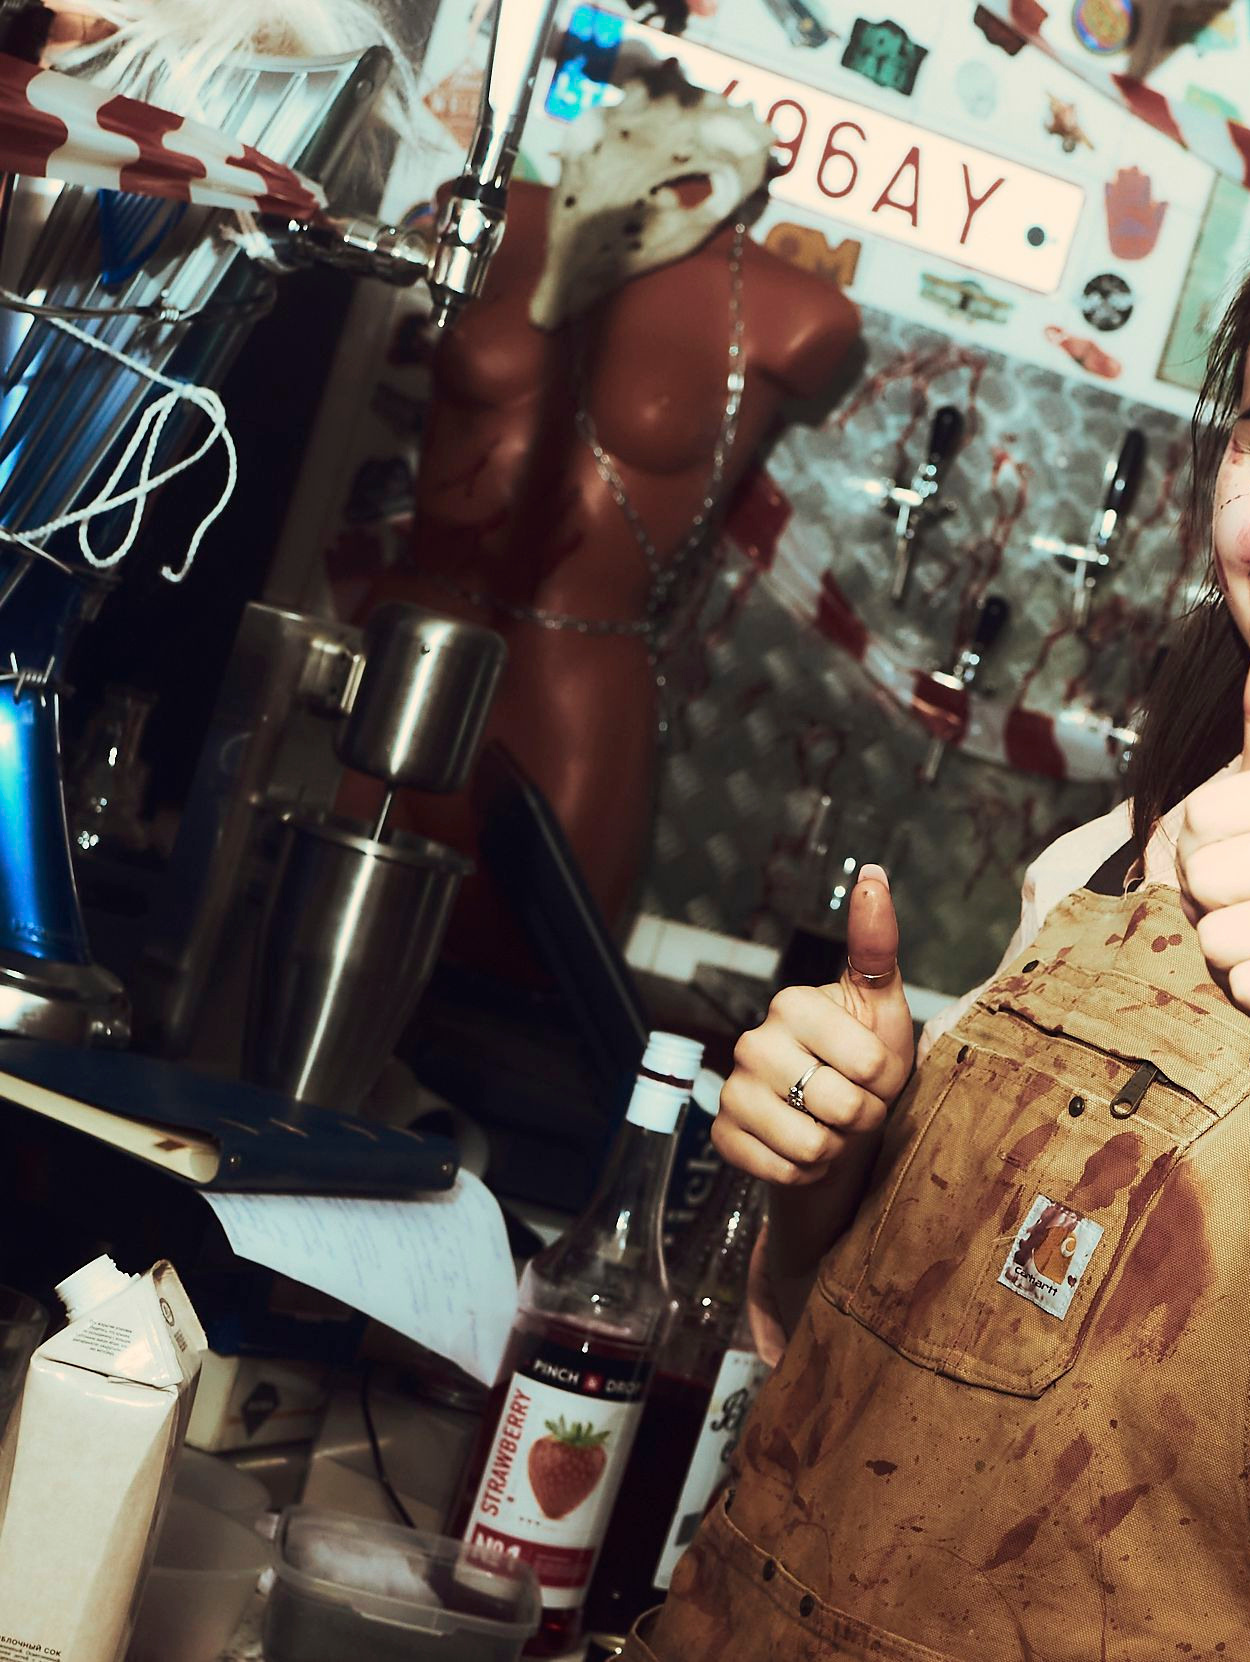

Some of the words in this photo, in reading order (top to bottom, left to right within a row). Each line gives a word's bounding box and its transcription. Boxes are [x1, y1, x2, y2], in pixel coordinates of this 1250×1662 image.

[722, 79, 1006, 245] 96AY
[533, 1359, 580, 1385] PINCH
[480, 1387, 532, 1517] STRAWBERRY
[0, 1635, 42, 1652] БЛОЧНЫЙ
